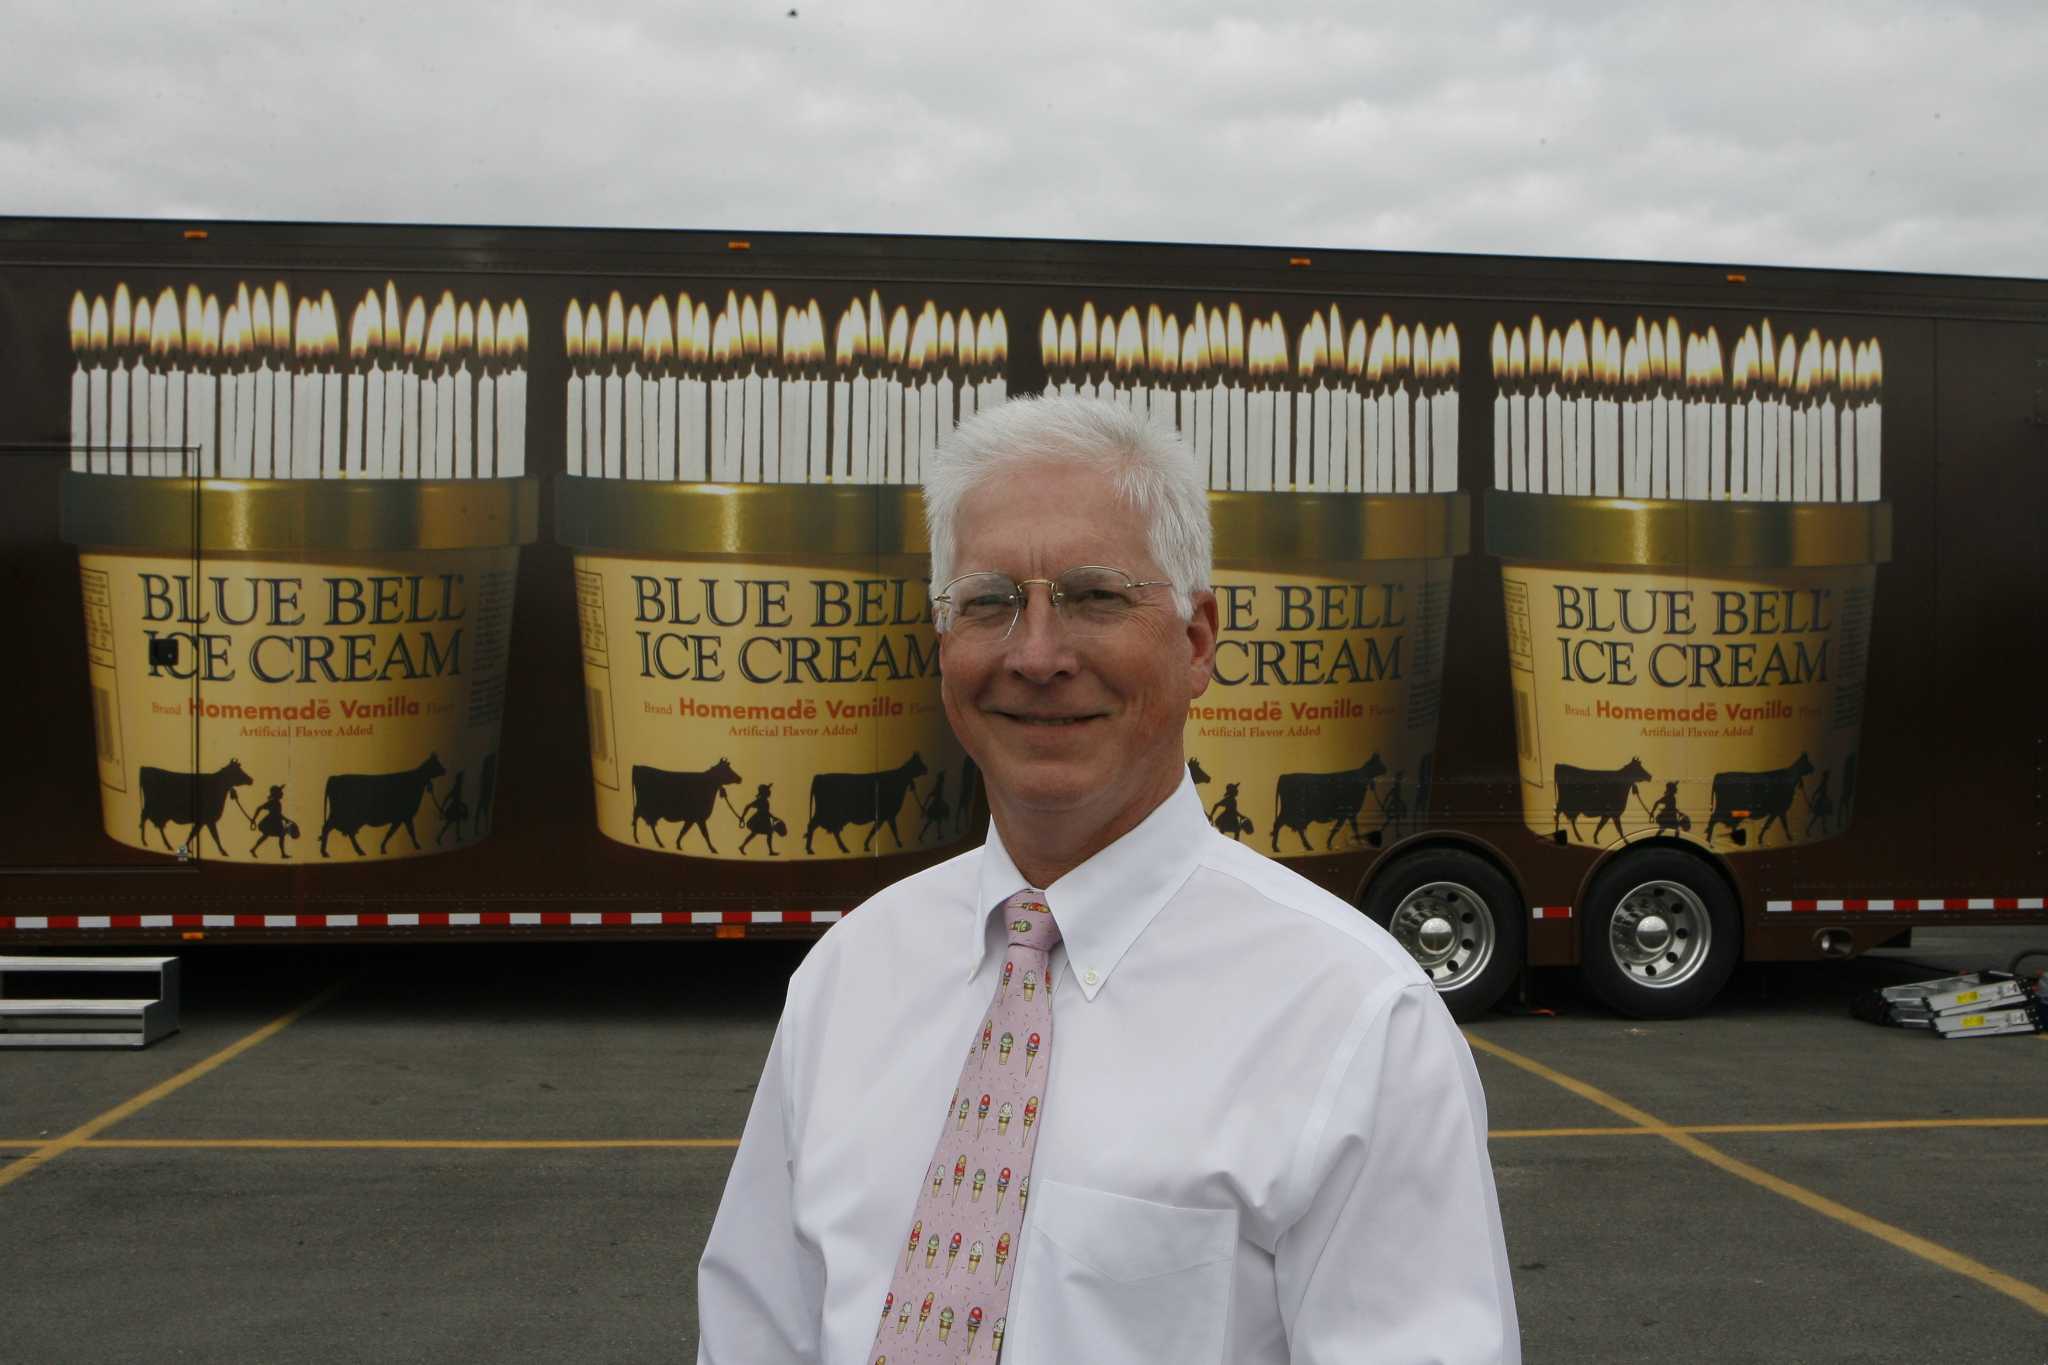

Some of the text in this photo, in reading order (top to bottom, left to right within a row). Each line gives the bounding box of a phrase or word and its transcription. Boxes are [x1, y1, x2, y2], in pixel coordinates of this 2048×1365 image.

[138, 573, 305, 626] BLUE
[323, 574, 465, 625] BELL
[631, 575, 792, 628] BLUE
[1276, 585, 1406, 632] BELL
[1554, 585, 1697, 635] BLUE
[1712, 588, 1833, 635] BELL
[248, 629, 464, 684] CREAM
[636, 630, 942, 684] ICE CREAM
[1211, 636, 1403, 688] CREAM
[1557, 637, 1829, 688] ICE CREAM
[151, 701, 182, 716] Brand
[340, 696, 420, 718] Vanilla
[643, 701, 673, 716] Brand
[679, 697, 817, 721] Homemade
[825, 696, 904, 719] Vanilla
[1290, 697, 1364, 720] Vanilla
[1595, 700, 1718, 722] Homemade
[1725, 699, 1793, 721] Vanilla
[240, 723, 374, 738] Artificial Flavor Added
[728, 723, 859, 738] Artificial Flavor Added
[1198, 725, 1321, 738] Artificial Flavor Added
[1640, 725, 1755, 738] Artificial Flavor Added
